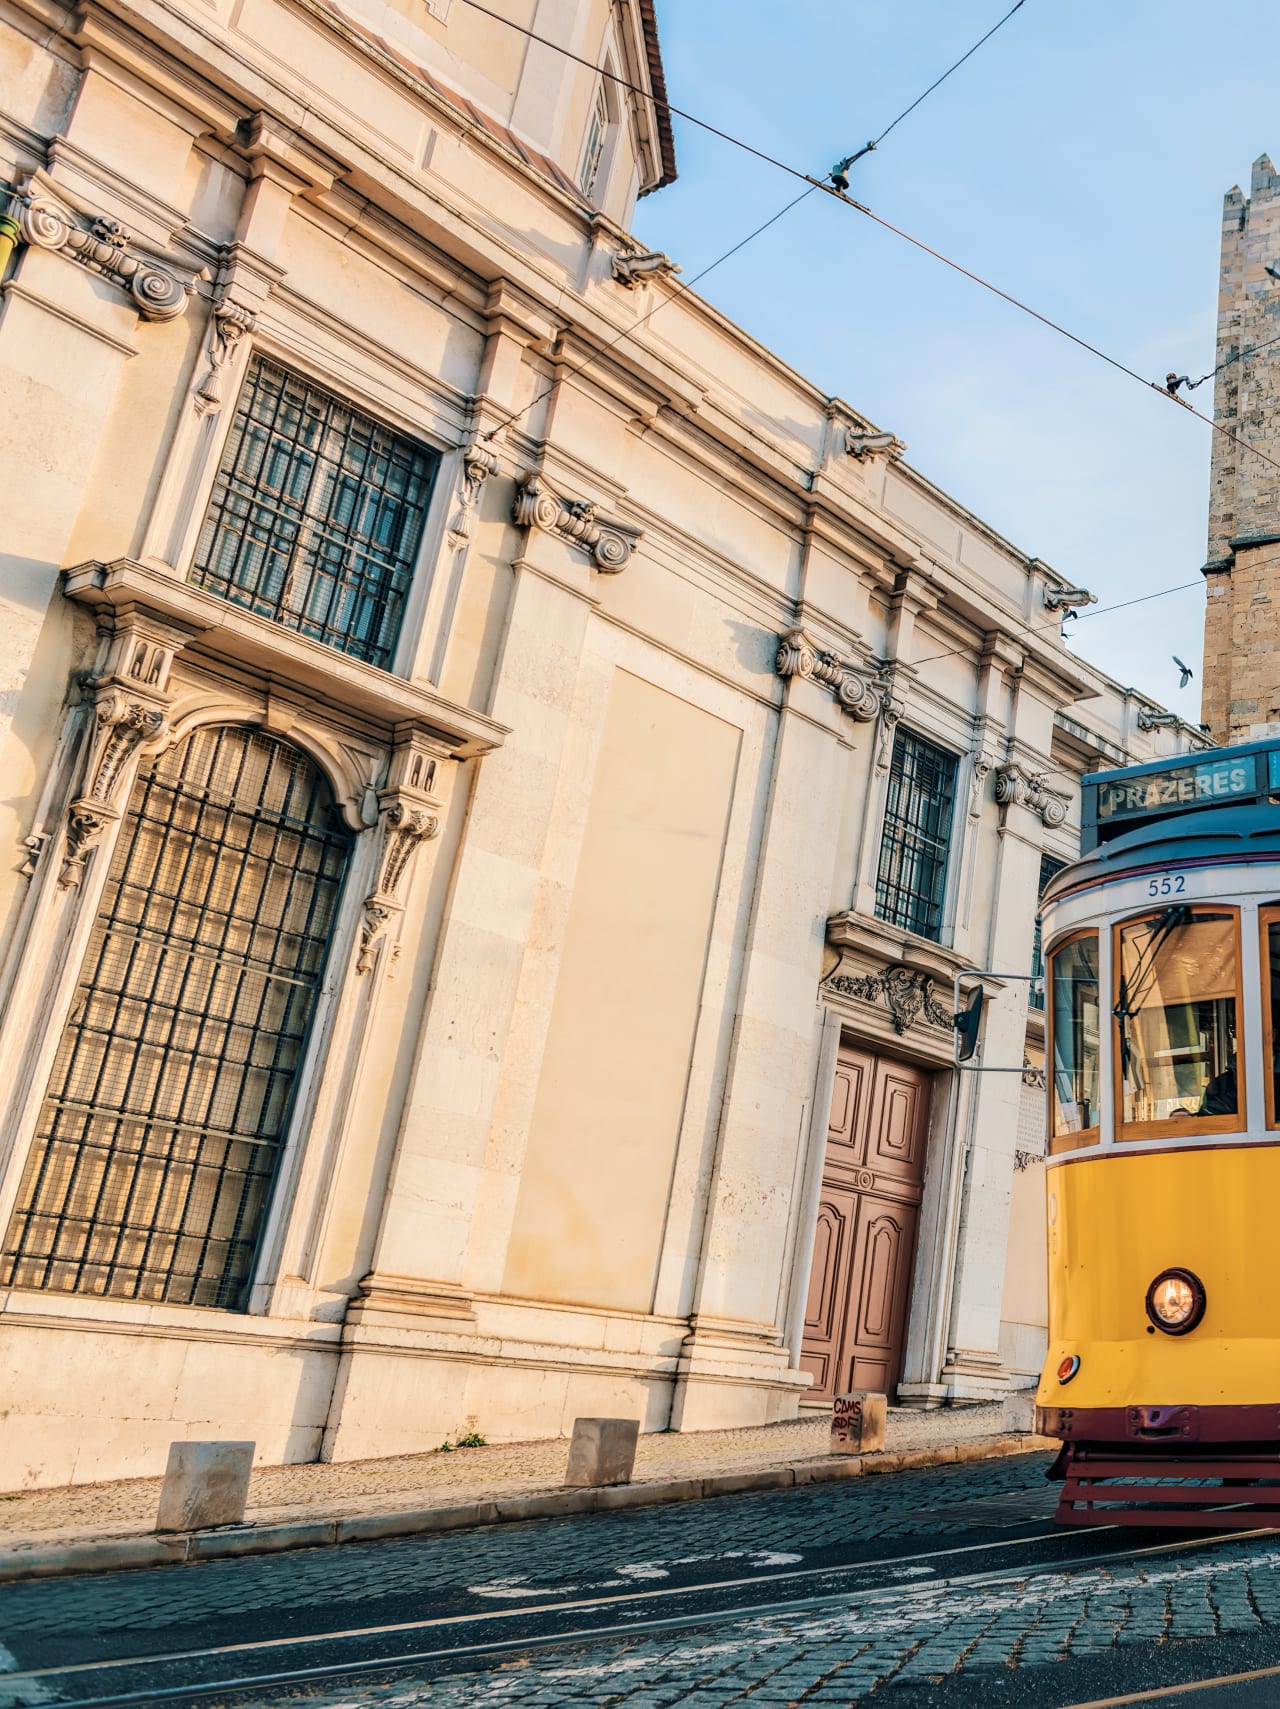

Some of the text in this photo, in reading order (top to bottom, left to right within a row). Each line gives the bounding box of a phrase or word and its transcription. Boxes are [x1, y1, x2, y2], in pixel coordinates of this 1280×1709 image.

[1110, 768, 1245, 811] PRAZERES
[1148, 875, 1186, 897] 552
[834, 1398, 861, 1414] CAMS
[834, 1416, 858, 1429] SDF
